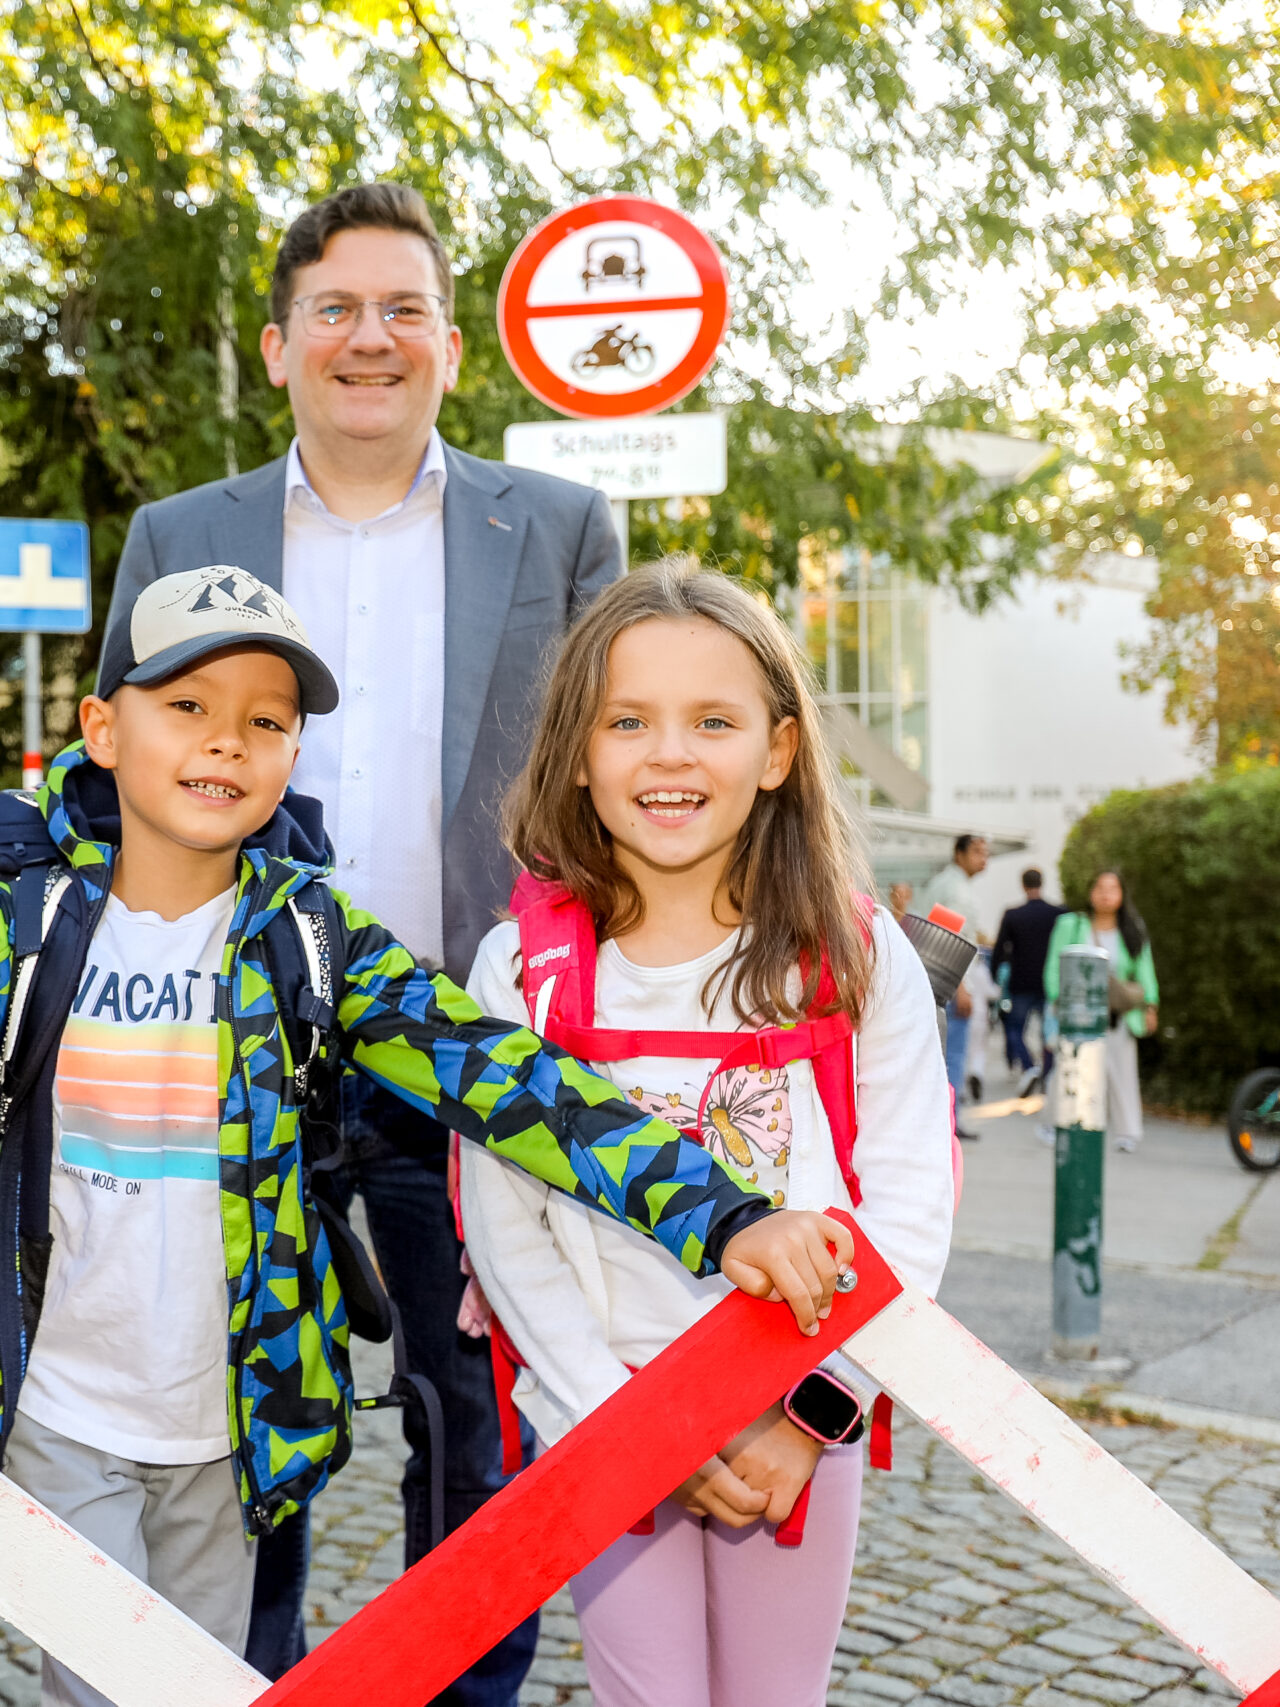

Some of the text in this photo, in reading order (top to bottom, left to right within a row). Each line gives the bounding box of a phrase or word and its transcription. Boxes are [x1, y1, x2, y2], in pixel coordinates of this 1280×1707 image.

[552, 431, 677, 457] Schultags
[528, 943, 571, 969] ergobag
[91, 1171, 118, 1193] MODE
[125, 1181, 141, 1195] ON
